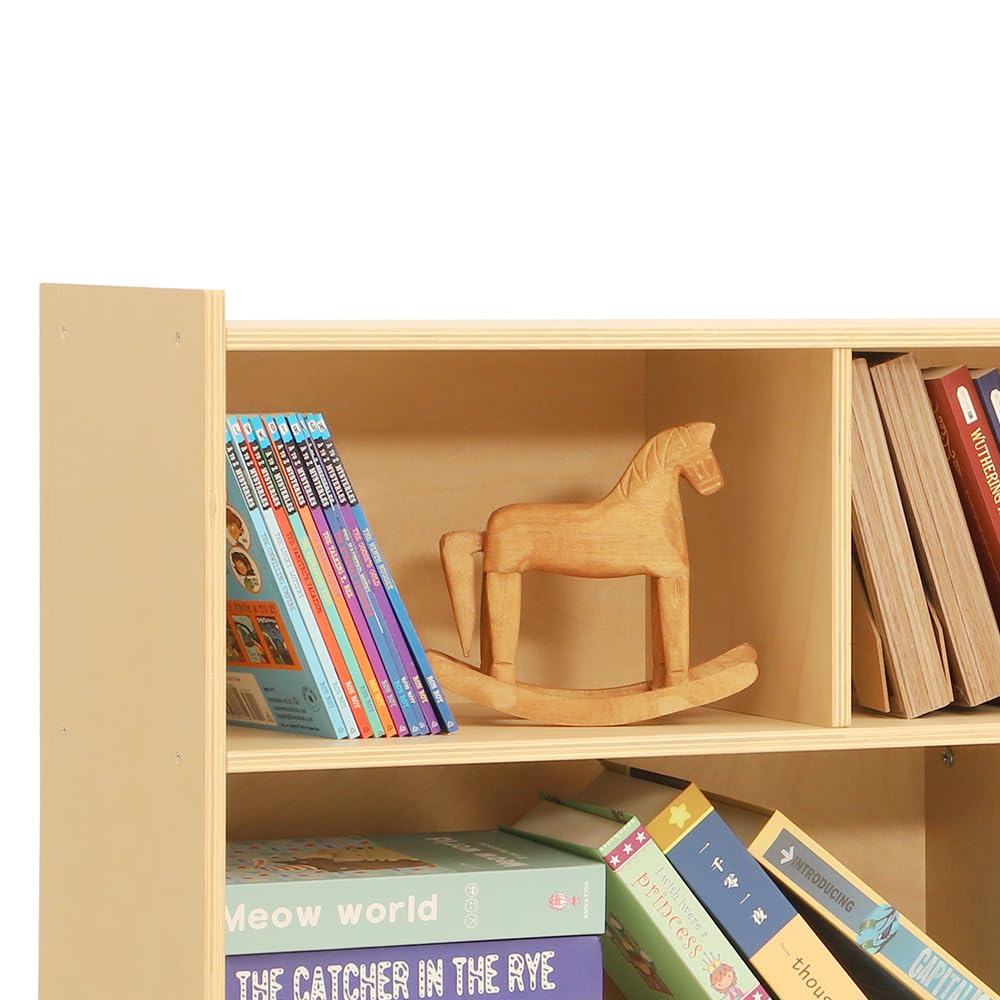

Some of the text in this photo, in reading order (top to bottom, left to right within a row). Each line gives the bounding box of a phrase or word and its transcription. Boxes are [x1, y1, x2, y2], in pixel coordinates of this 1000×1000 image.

[661, 874, 680, 901] wish
[698, 842, 768, 926] 一千零一夜
[792, 857, 856, 914] INTRODUCING
[225, 893, 438, 932] Meow world
[633, 872, 704, 960] princess
[418, 958, 444, 999] IN
[452, 954, 500, 996] THE
[508, 950, 557, 992] RYE
